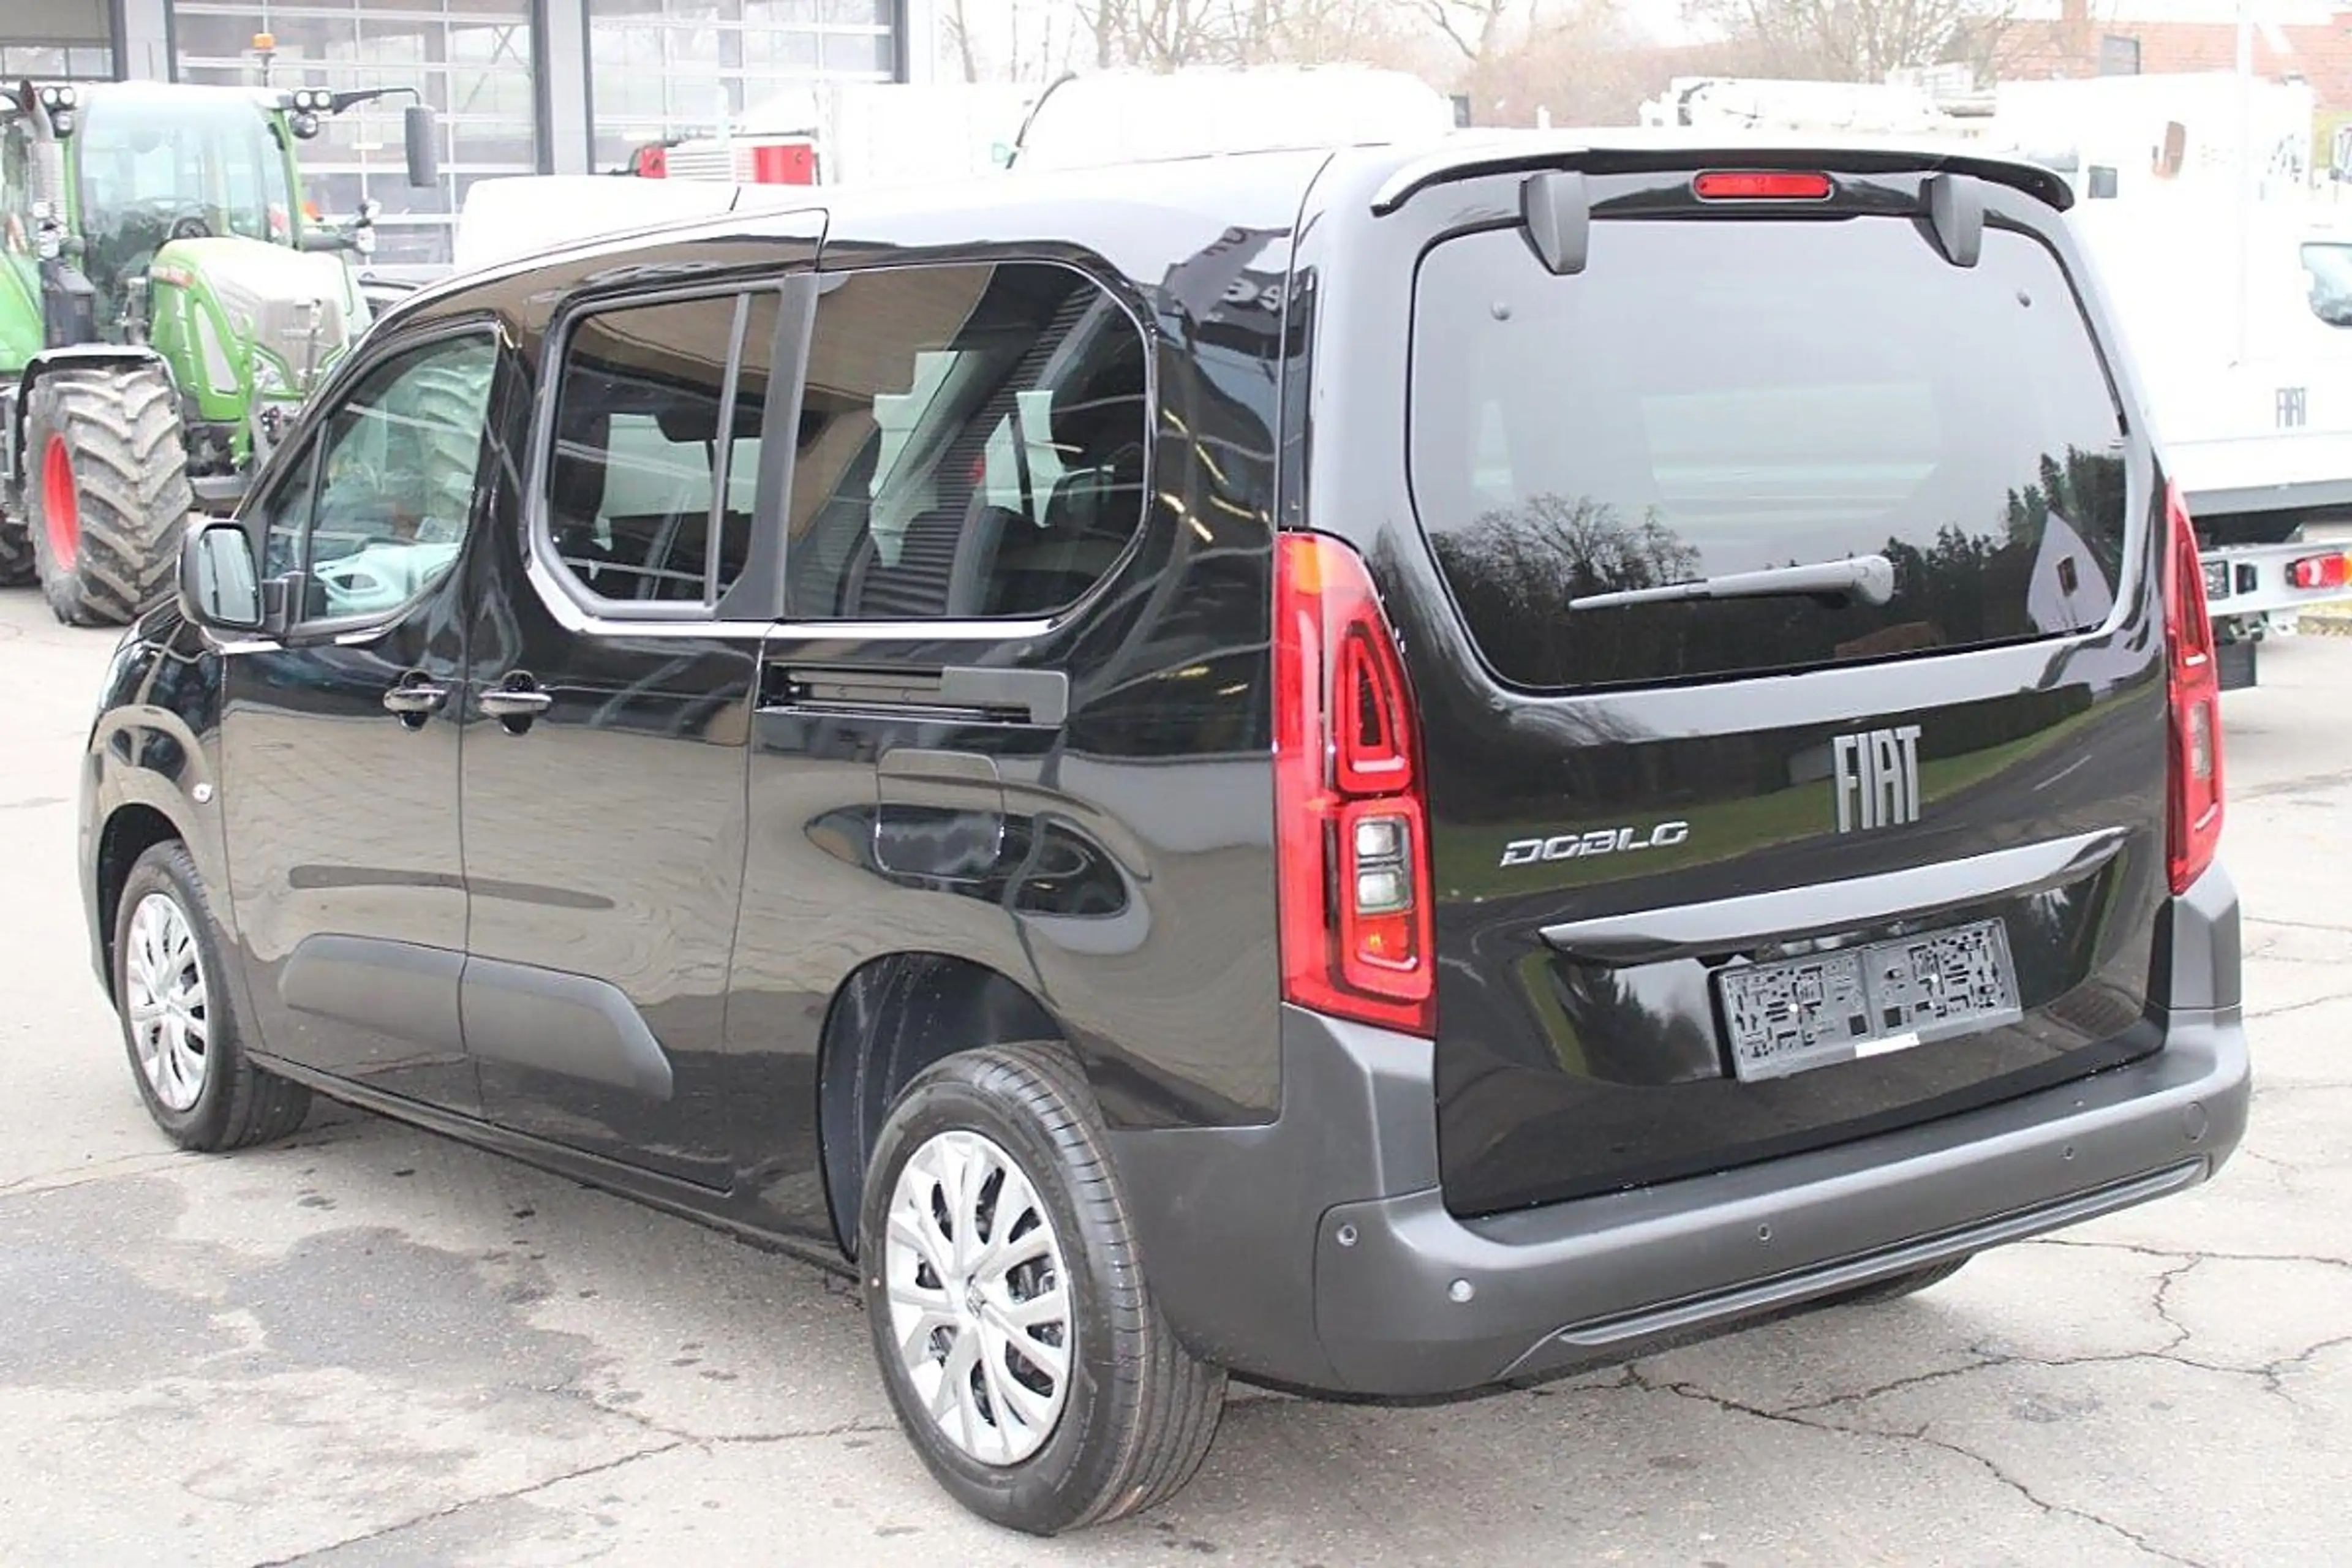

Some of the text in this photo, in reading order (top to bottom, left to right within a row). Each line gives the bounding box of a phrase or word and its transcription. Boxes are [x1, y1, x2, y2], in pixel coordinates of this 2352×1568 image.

[2275, 387, 2307, 428] FIAT
[1833, 725, 1921, 834] FIAT
[1500, 821, 1689, 867] DOBLO
